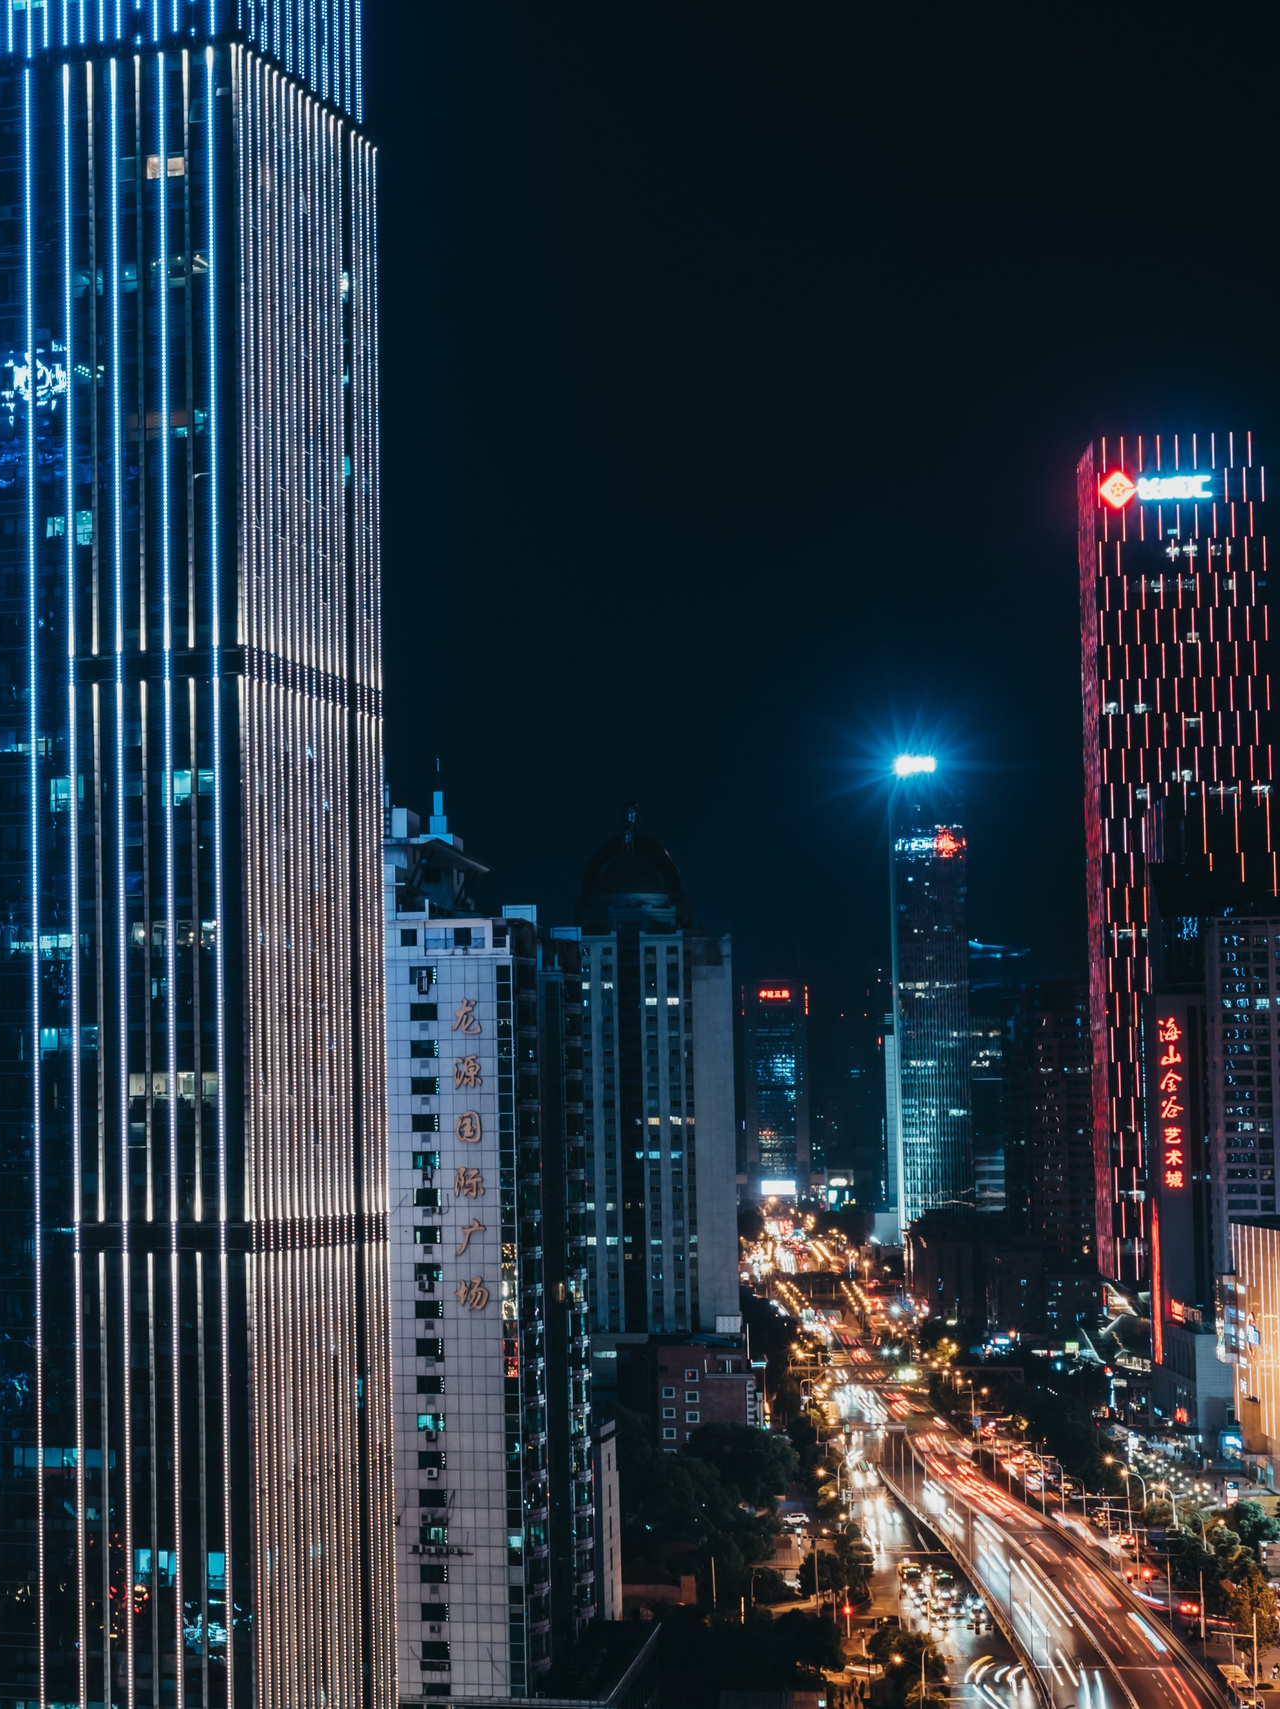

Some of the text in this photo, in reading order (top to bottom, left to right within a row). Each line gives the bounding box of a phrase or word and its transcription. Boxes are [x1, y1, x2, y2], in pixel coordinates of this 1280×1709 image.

[452, 998, 489, 1311] 龙源国际广场
[1158, 1017, 1184, 1188] 海山金谷艺术城
